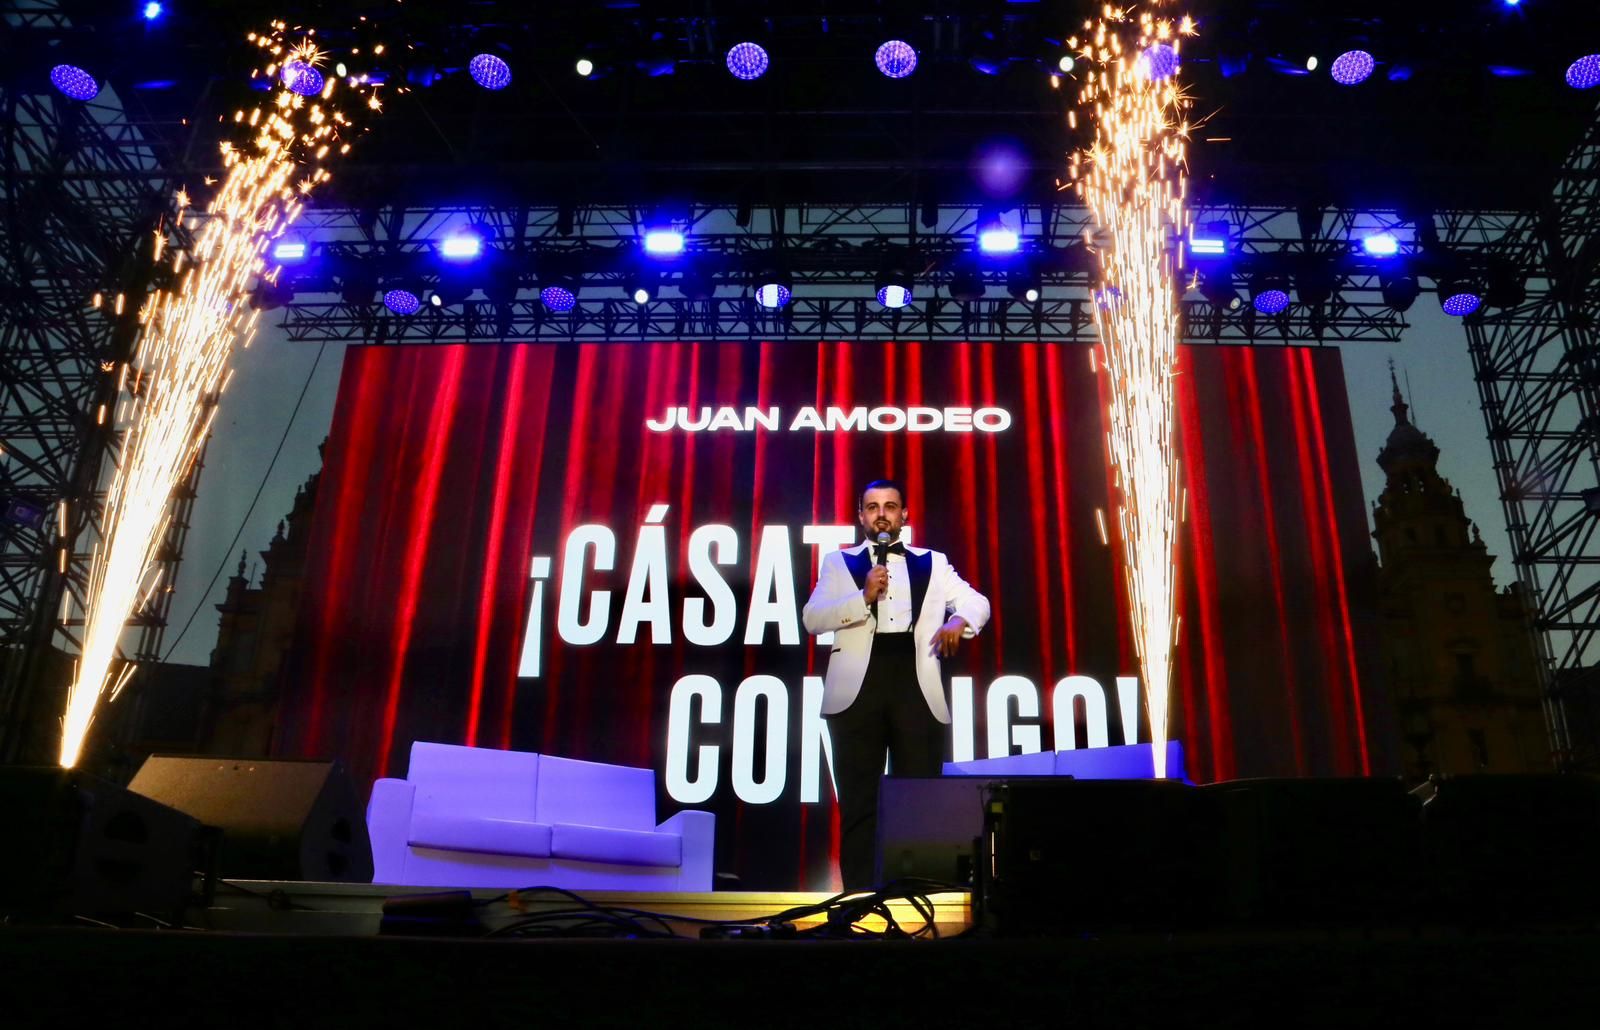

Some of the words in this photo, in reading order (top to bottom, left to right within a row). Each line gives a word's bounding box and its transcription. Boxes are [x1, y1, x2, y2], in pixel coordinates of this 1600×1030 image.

[646, 406, 780, 433] JUAN
[789, 406, 1012, 433] AMODEO
[518, 504, 912, 678] ¡CÁSAT
[665, 674, 1139, 804] CONIGO!
